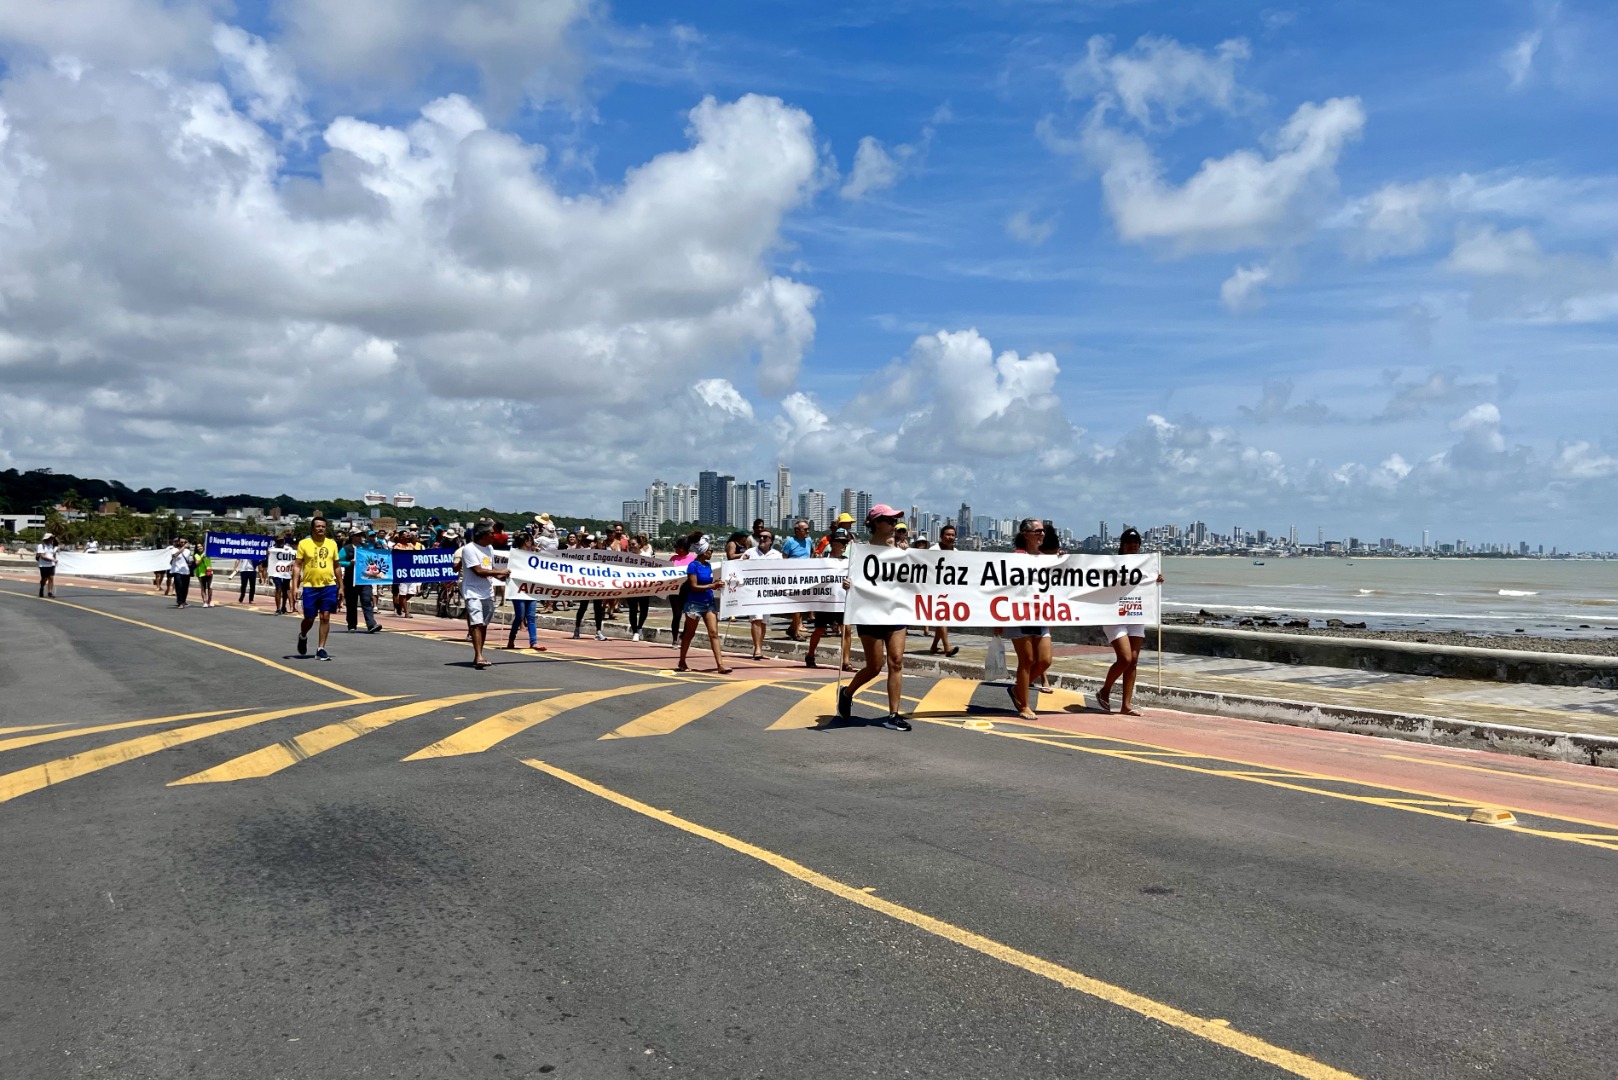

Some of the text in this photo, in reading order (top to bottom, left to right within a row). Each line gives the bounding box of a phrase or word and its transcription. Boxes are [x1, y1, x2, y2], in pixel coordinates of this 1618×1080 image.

[213, 537, 225, 545] Novo
[226, 538, 240, 546] Plano
[241, 538, 260, 547] Diretor
[593, 553, 622, 562] Engorda
[625, 556, 638, 564] das
[396, 569, 407, 578] OS
[410, 568, 440, 577] CORAIS
[528, 555, 573, 573] Quem
[579, 566, 621, 578] cuida
[863, 554, 1142, 592] Quem faz Alargamento
[558, 574, 605, 588] Todos
[612, 578, 664, 589] Contra
[743, 577, 770, 586] PREFEITO:
[772, 575, 785, 584] NÃO
[788, 575, 798, 584] DÁ
[800, 576, 818, 584] PARA
[517, 582, 622, 598] Alargamento
[763, 589, 787, 597] CIDADE
[915, 594, 1080, 622] Não Cuida.
